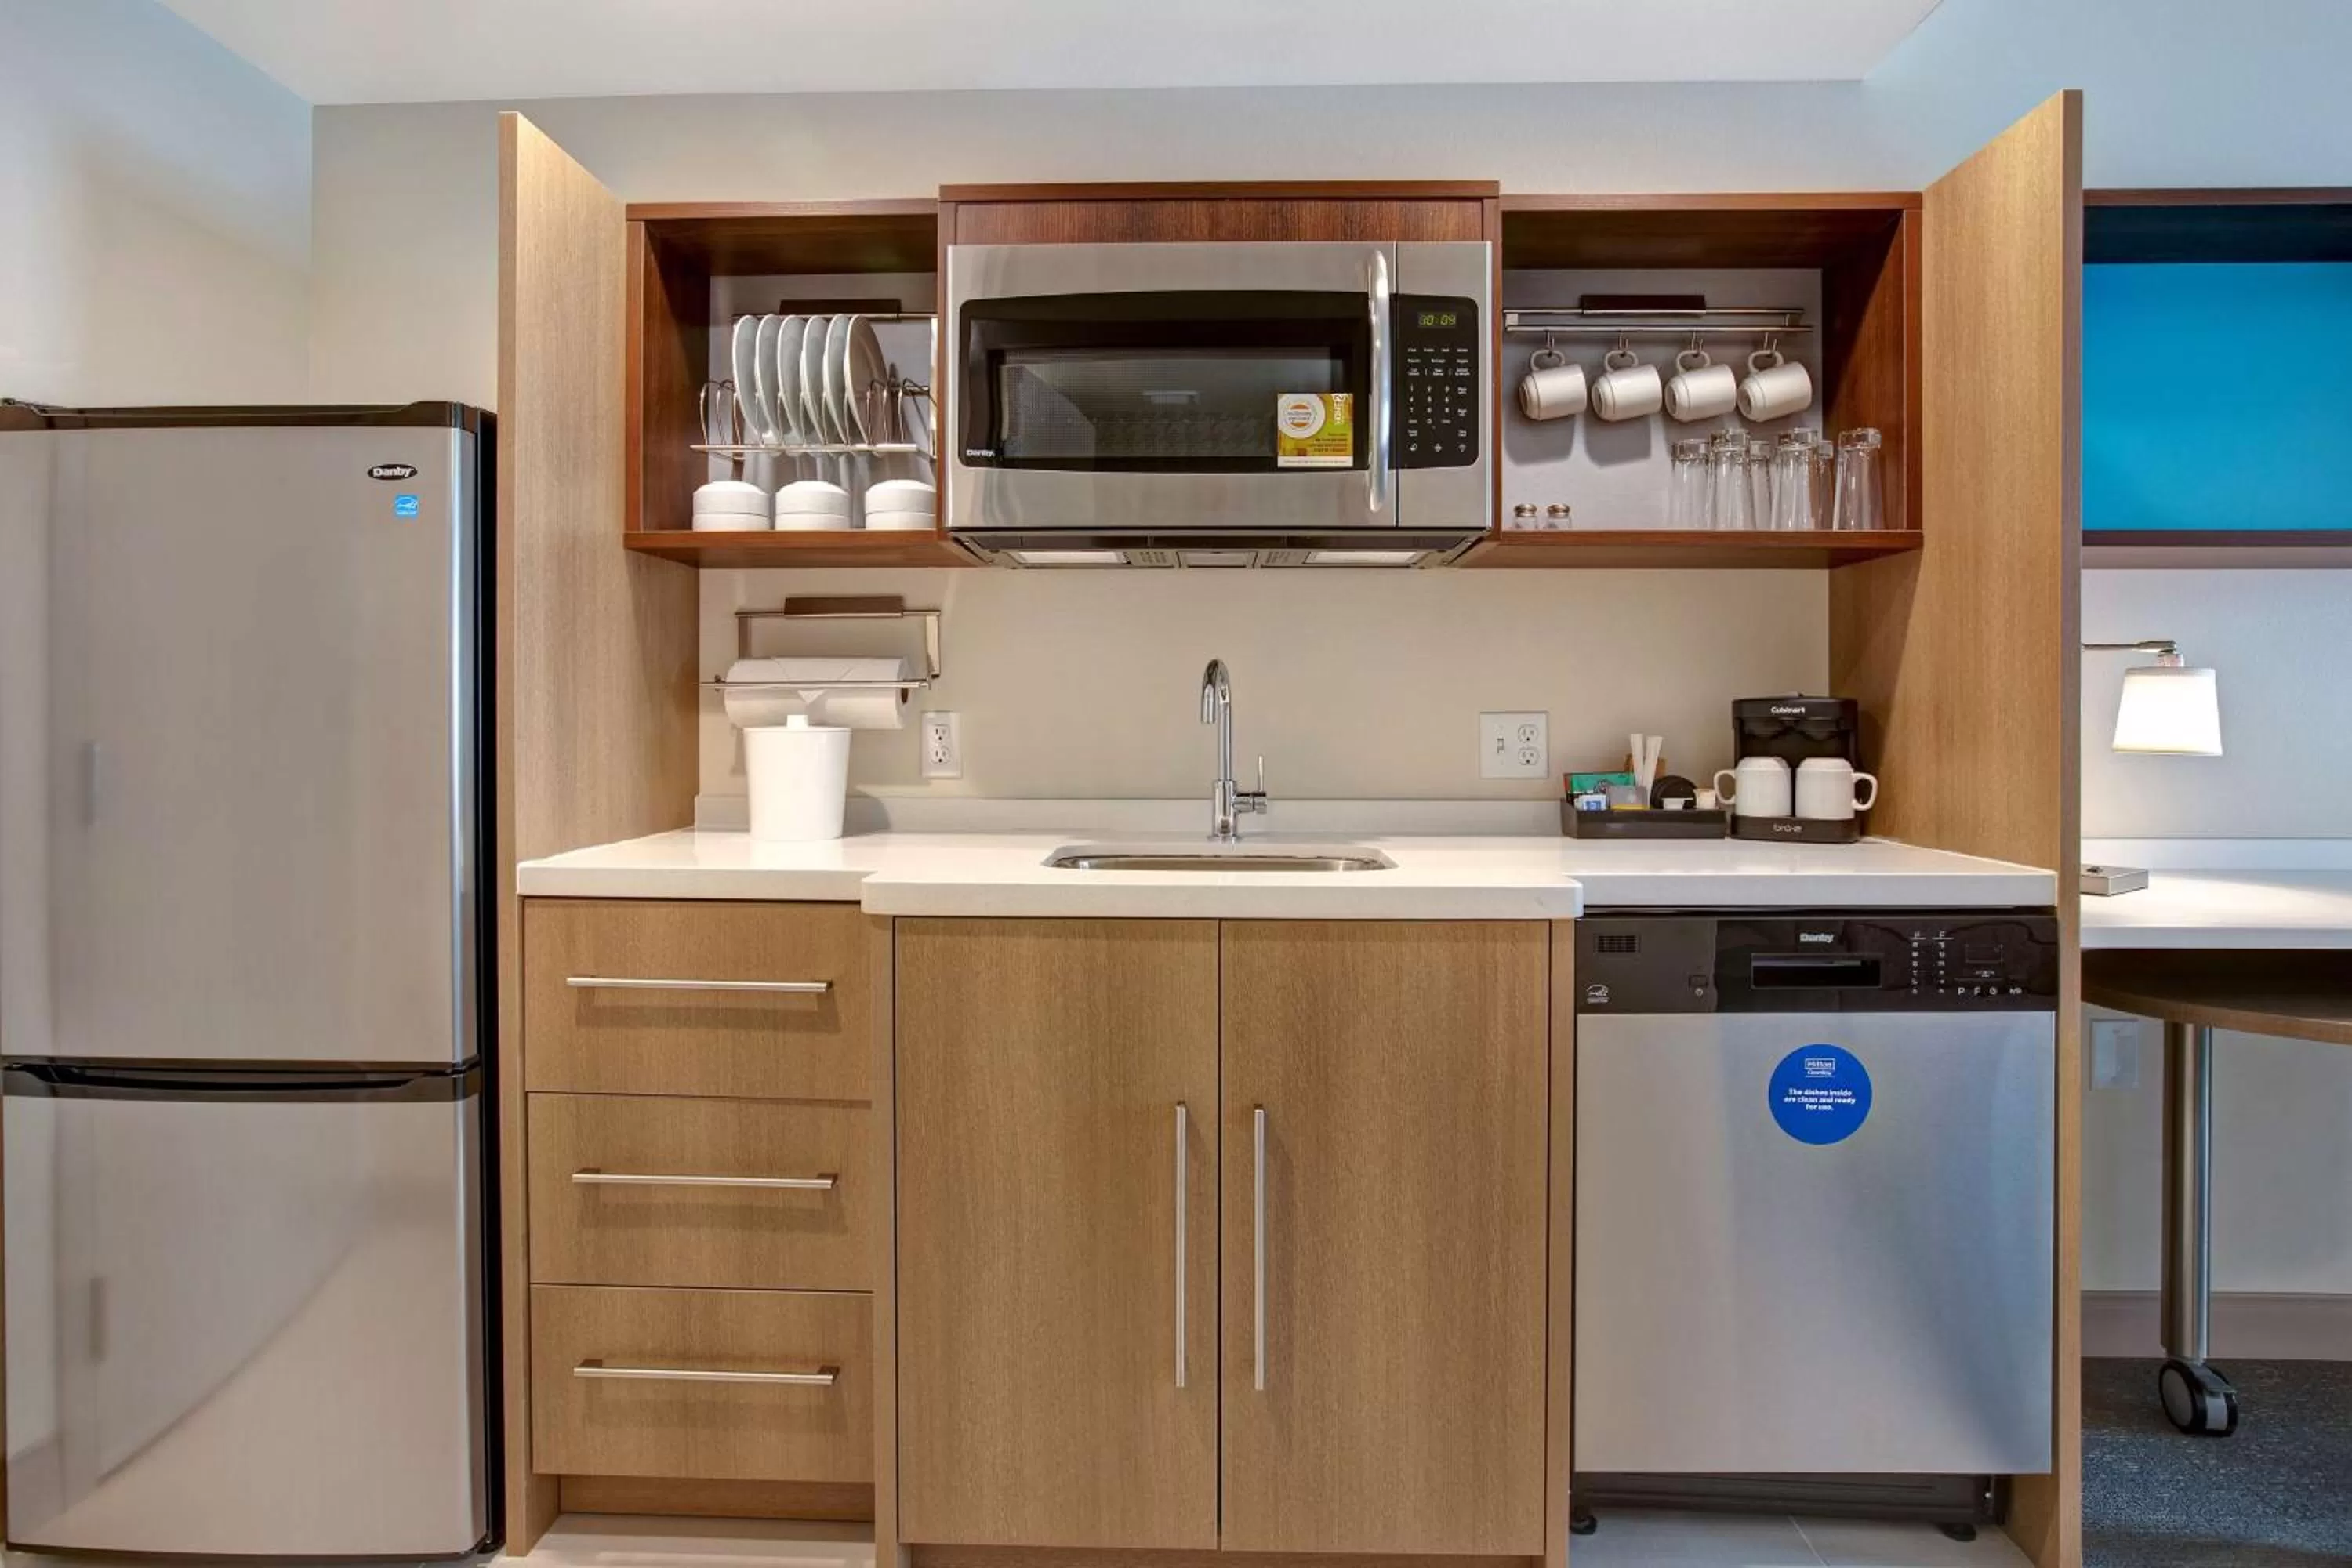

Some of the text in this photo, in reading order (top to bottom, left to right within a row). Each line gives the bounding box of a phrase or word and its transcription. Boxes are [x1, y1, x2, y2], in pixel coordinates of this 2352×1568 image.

[373, 467, 414, 477] Danby
[1799, 933, 1834, 943] Danby
[1834, 1096, 1856, 1105] ready
